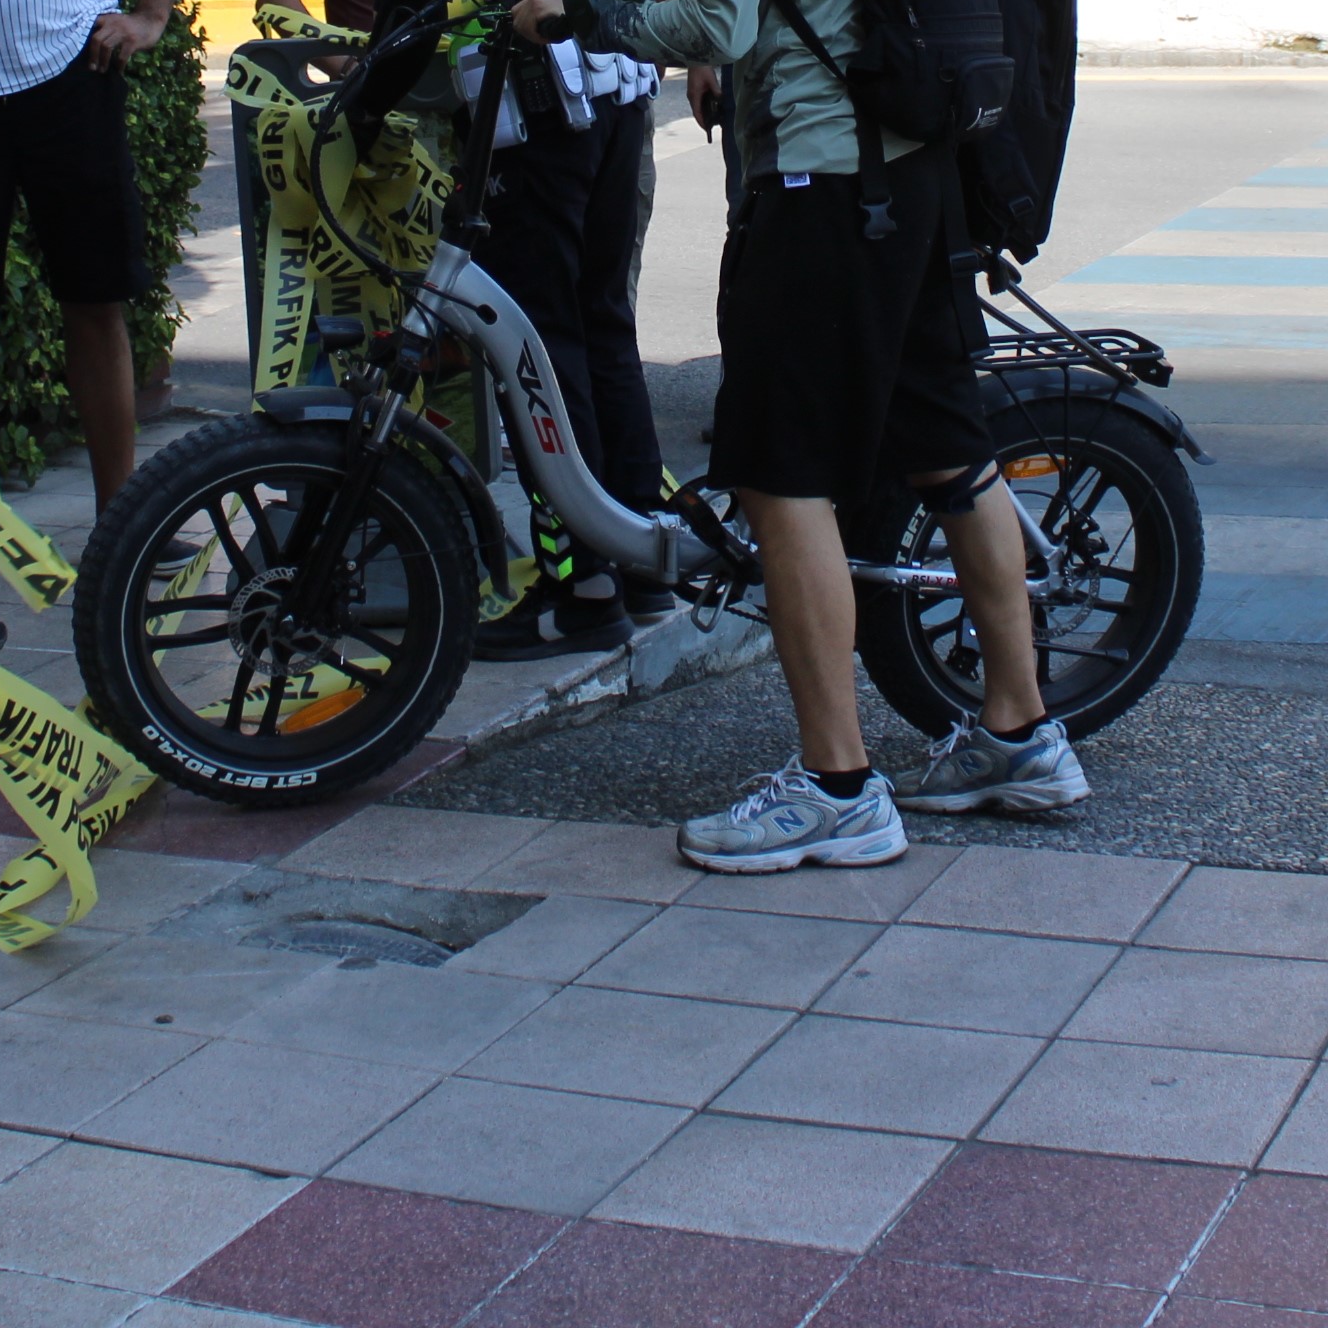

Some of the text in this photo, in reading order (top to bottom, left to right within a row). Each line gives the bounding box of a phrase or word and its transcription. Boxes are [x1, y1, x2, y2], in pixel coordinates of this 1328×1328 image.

[516, 338, 565, 455] RKS
[901, 502, 926, 549] BFT
[218, 772, 269, 789] BFT
[272, 771, 318, 789] CST
[772, 808, 808, 836] N
